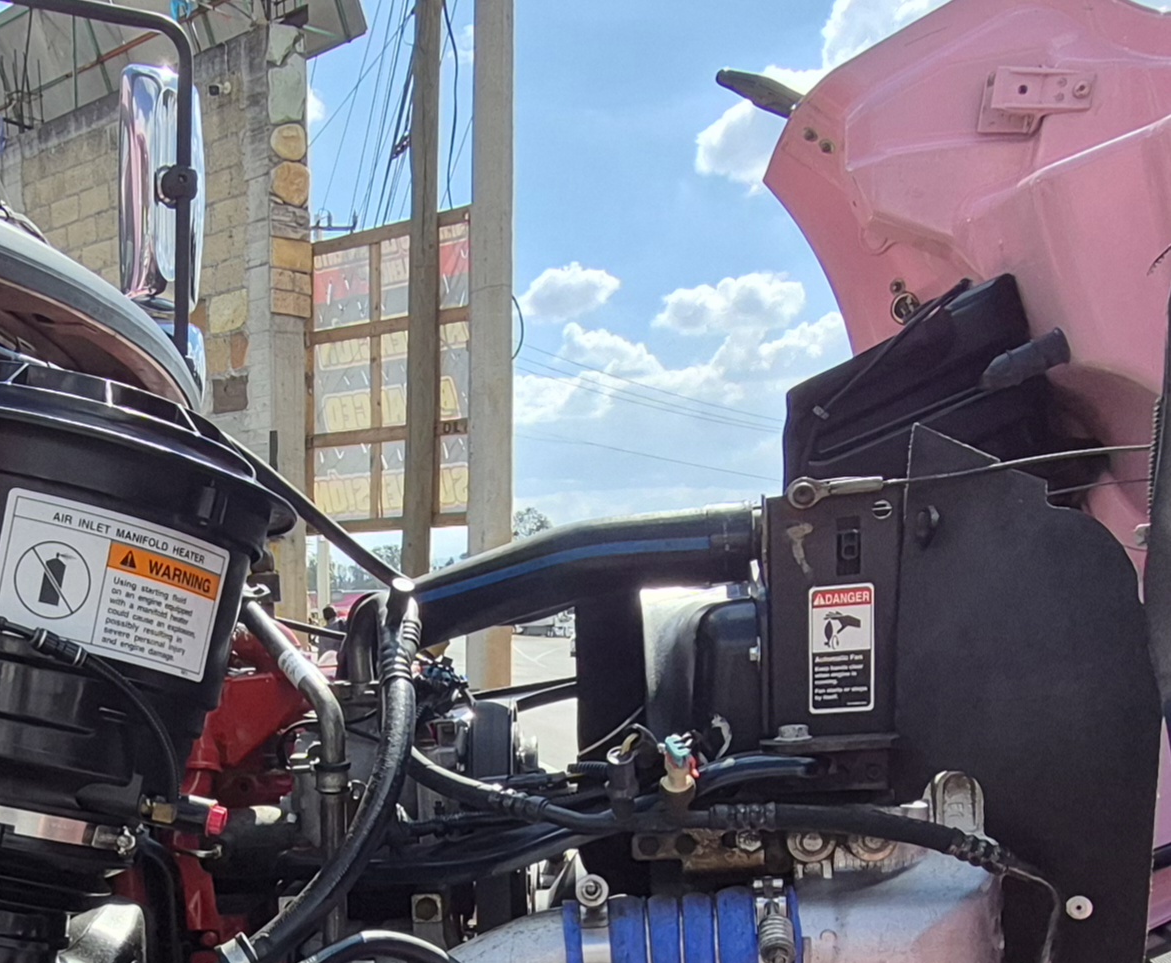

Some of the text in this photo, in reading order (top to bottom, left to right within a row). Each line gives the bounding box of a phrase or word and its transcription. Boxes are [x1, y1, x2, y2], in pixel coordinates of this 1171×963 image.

[53, 512, 205, 564] AIR INLET MANIFOLD HEATER
[149, 559, 211, 593] WARNING
[114, 577, 187, 604] Using starting fluid
[825, 591, 870, 604] DANGER
[108, 608, 129, 618] could
[132, 615, 153, 625] cause
[110, 598, 125, 606] with
[137, 605, 168, 618] manifold
[170, 614, 188, 625] heater
[138, 596, 162, 607] engine
[165, 604, 193, 616] equipped
[104, 627, 185, 656] severe personal injury
[105, 617, 139, 632] possibly
[143, 628, 173, 643] resulting
[102, 637, 117, 645] and
[120, 642, 144, 651] engine
